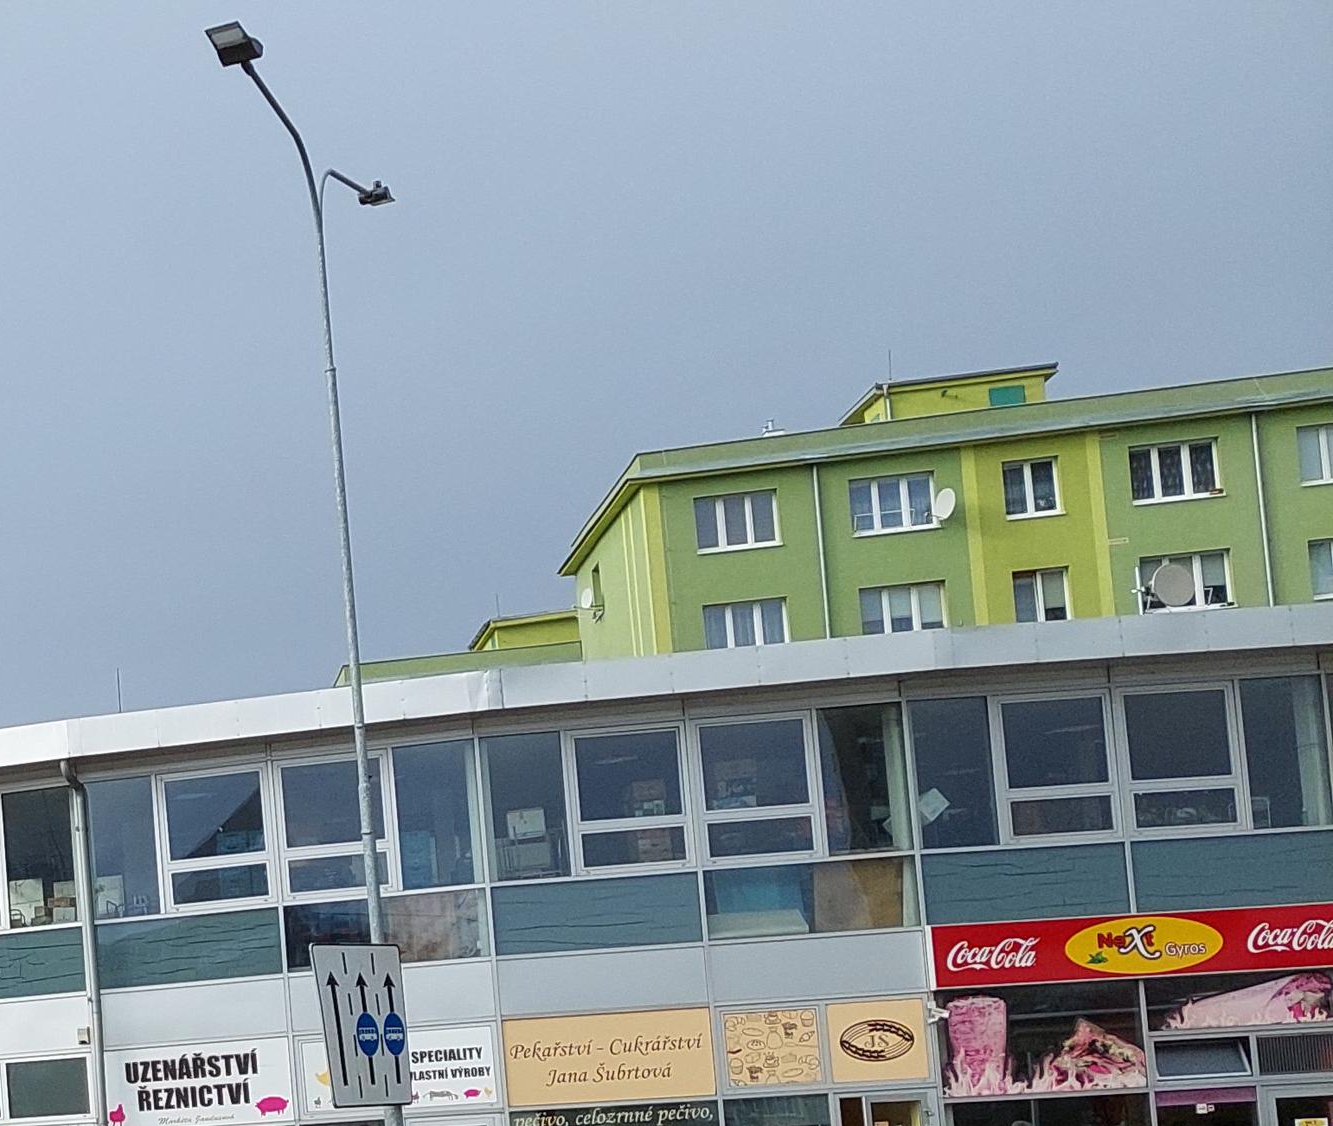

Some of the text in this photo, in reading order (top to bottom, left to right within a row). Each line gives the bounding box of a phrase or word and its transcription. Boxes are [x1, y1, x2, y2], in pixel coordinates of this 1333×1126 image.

[946, 937, 1041, 972] Coca-Cola
[1165, 942, 1206, 960] Gyros
[411, 1046, 483, 1064] SPECIALITY
[509, 1039, 593, 1062] Pekařství
[609, 1033, 703, 1056] Cukrářství
[125, 1048, 259, 1085] UZENÁŘSTVÍ
[450, 1066, 491, 1079] VÝROBY
[545, 1061, 672, 1087] Jana Šubrtová
[138, 1078, 251, 1112] ŘEZNICTVÍ
[575, 1106, 653, 1126] celozrnné
[657, 1104, 714, 1126] pečivo,
